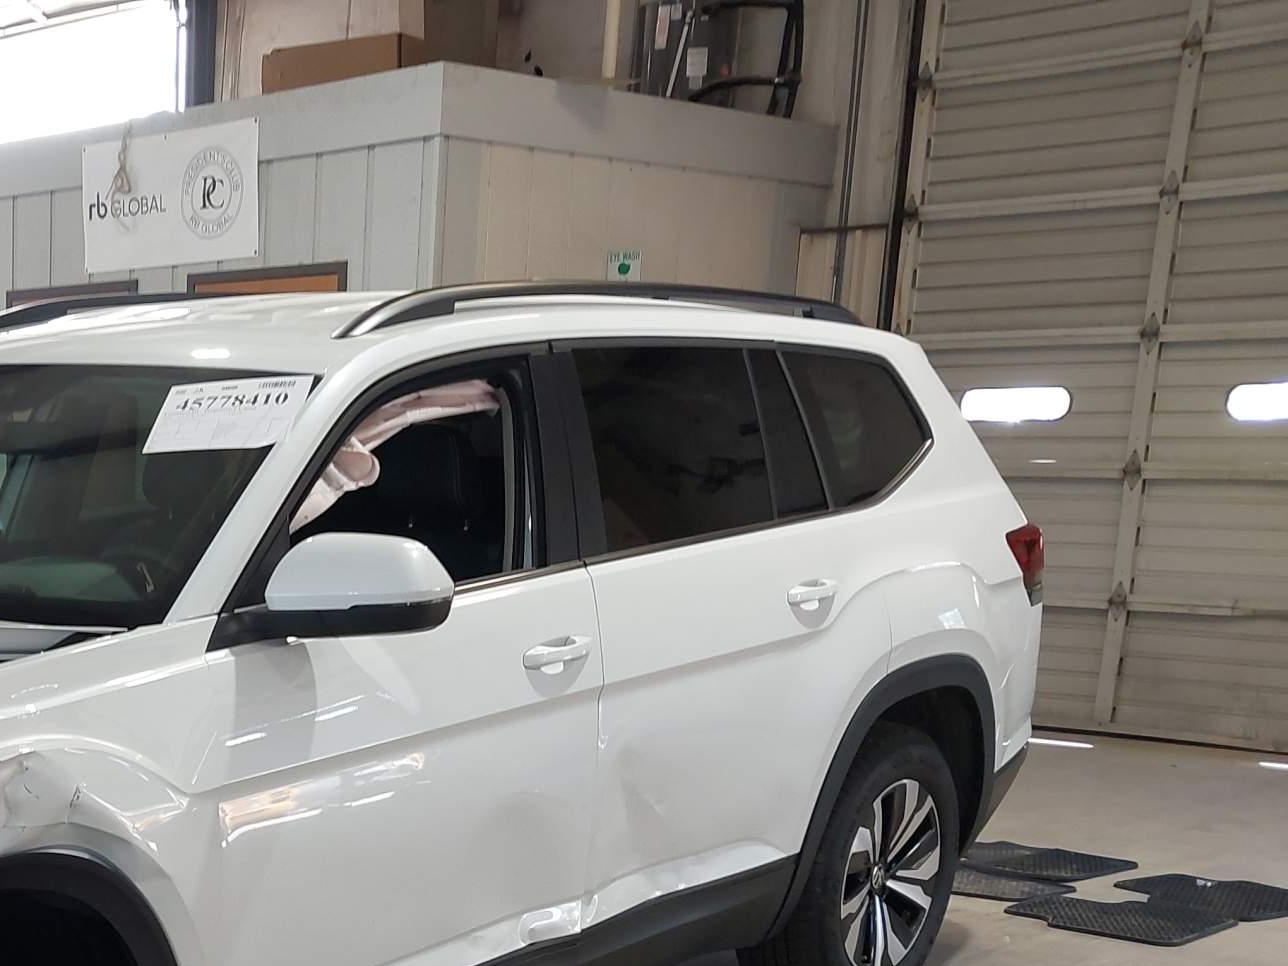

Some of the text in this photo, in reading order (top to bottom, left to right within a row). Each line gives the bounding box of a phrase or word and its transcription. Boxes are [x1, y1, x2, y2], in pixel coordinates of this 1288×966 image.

[224, 160, 241, 193] CLUB
[88, 191, 166, 221] rb GLOBAL
[201, 212, 234, 234] GLOBAL
[622, 250, 640, 262] WASH
[175, 391, 289, 412] 45778410
